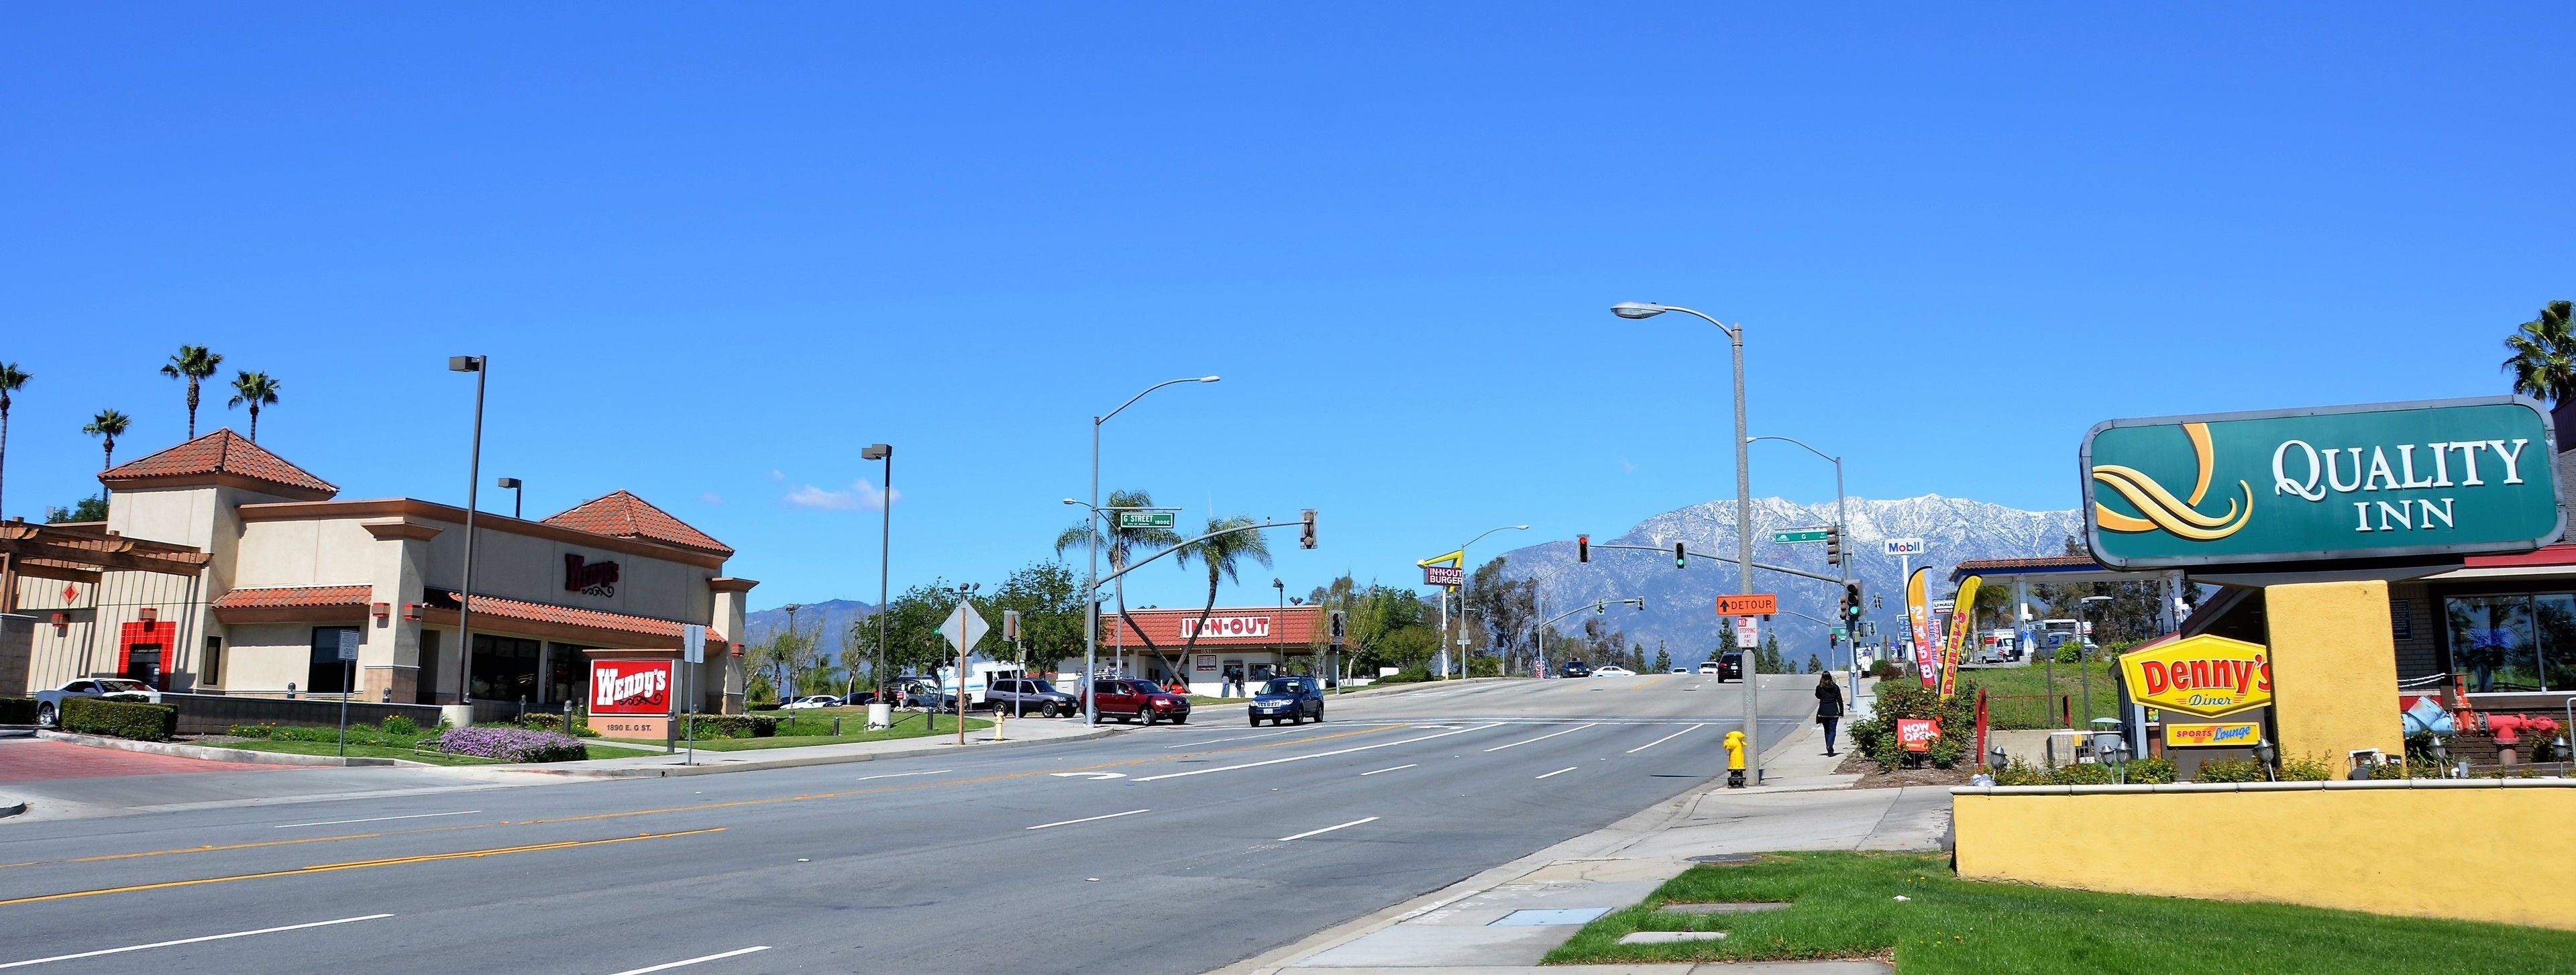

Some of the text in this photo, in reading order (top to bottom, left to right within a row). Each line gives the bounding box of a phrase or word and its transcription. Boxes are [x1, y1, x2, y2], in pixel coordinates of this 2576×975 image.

[2272, 438, 2528, 501] QUALITY
[1130, 515, 1153, 523] STREET
[2353, 498, 2455, 531] INN
[1888, 542, 1920, 552] Mobil
[1430, 568, 1462, 577] IN-N-OUT
[1430, 575, 1462, 584] BURGER
[1731, 600, 1772, 610] DETOUR
[1909, 605, 1924, 620] $2
[1738, 619, 1746, 627] NO
[1913, 624, 1926, 639] $4
[1944, 609, 1968, 695] Denny's
[2141, 654, 2271, 696] Denny's
[2188, 694, 2233, 706] Diner
[1902, 722, 1929, 733] NOW
[2212, 726, 2250, 741] Lounge
